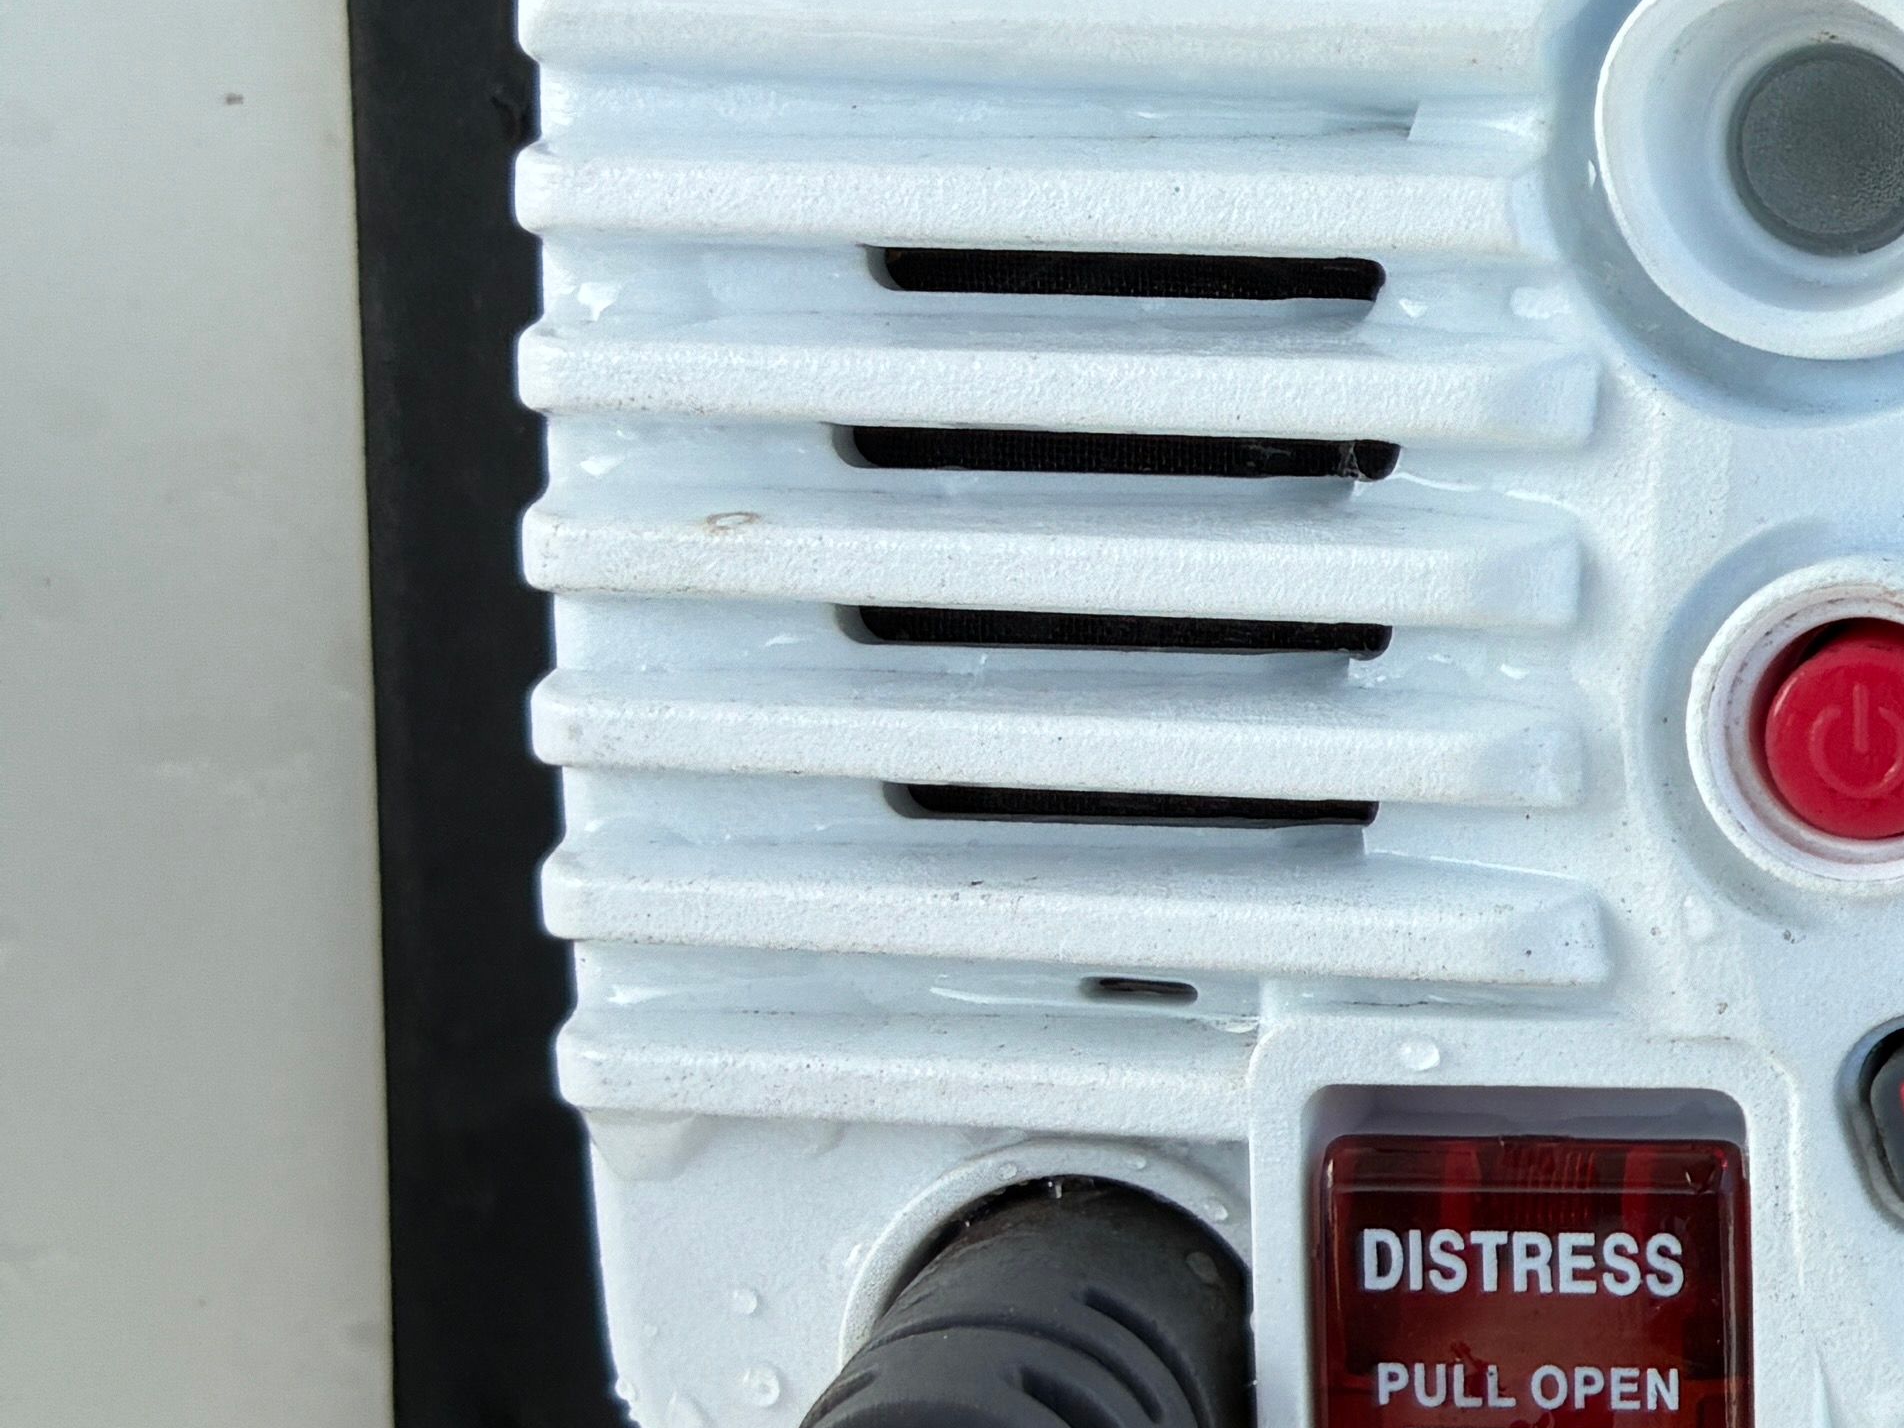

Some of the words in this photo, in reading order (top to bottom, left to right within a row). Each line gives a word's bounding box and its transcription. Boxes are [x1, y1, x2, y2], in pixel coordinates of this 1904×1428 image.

[1362, 1227, 1685, 1298] DISTRESS
[1376, 1361, 1518, 1409] PULL
[1529, 1363, 1680, 1412] OPEN
